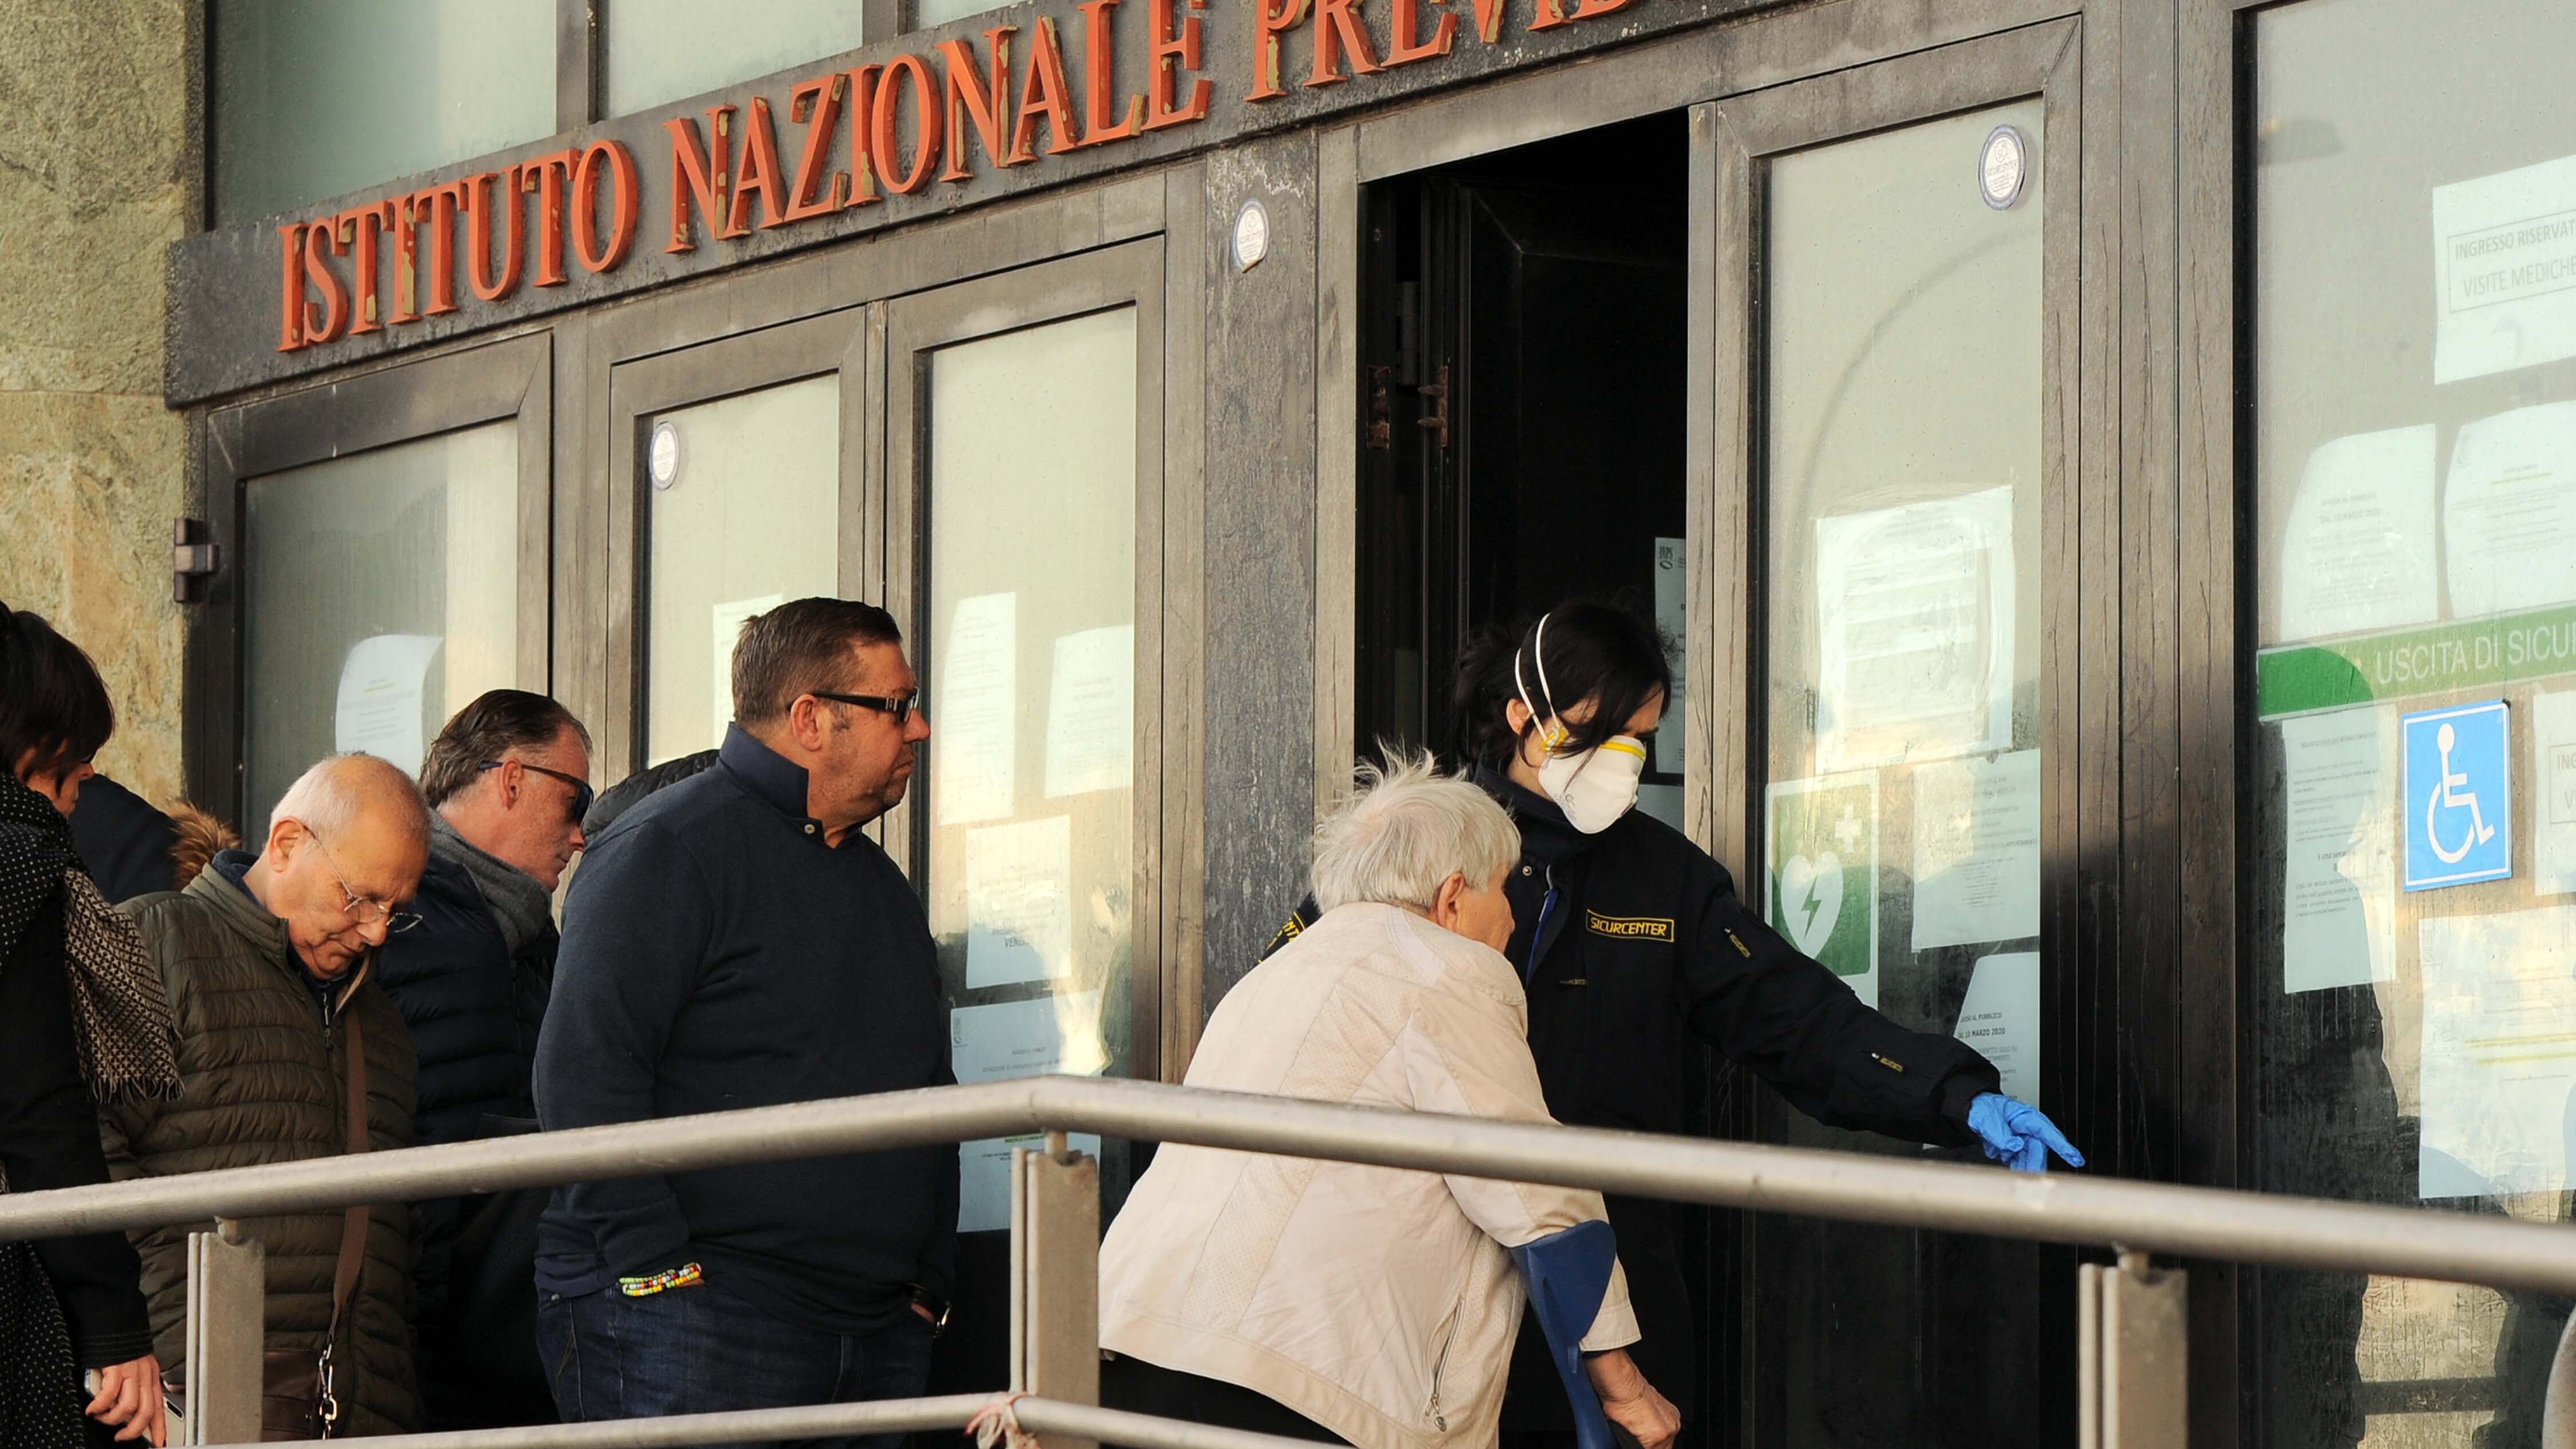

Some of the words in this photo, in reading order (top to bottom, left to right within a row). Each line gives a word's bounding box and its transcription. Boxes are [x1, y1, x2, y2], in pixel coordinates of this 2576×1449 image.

[276, 139, 638, 352] ISTITUTO
[662, 0, 1212, 254] NAZIONALE
[2455, 232, 2515, 260] INGRESSO
[2463, 270, 2507, 298] VISITE
[2511, 255, 2576, 289] MEDICHE
[2376, 639, 2469, 685] USCITA
[2475, 634, 2499, 670] DI
[2507, 621, 2576, 666] SICU
[1590, 917, 1667, 937] SICURCENTER
[1971, 1029, 1990, 1037] MARZO
[1991, 1026, 2006, 1036] 2020
